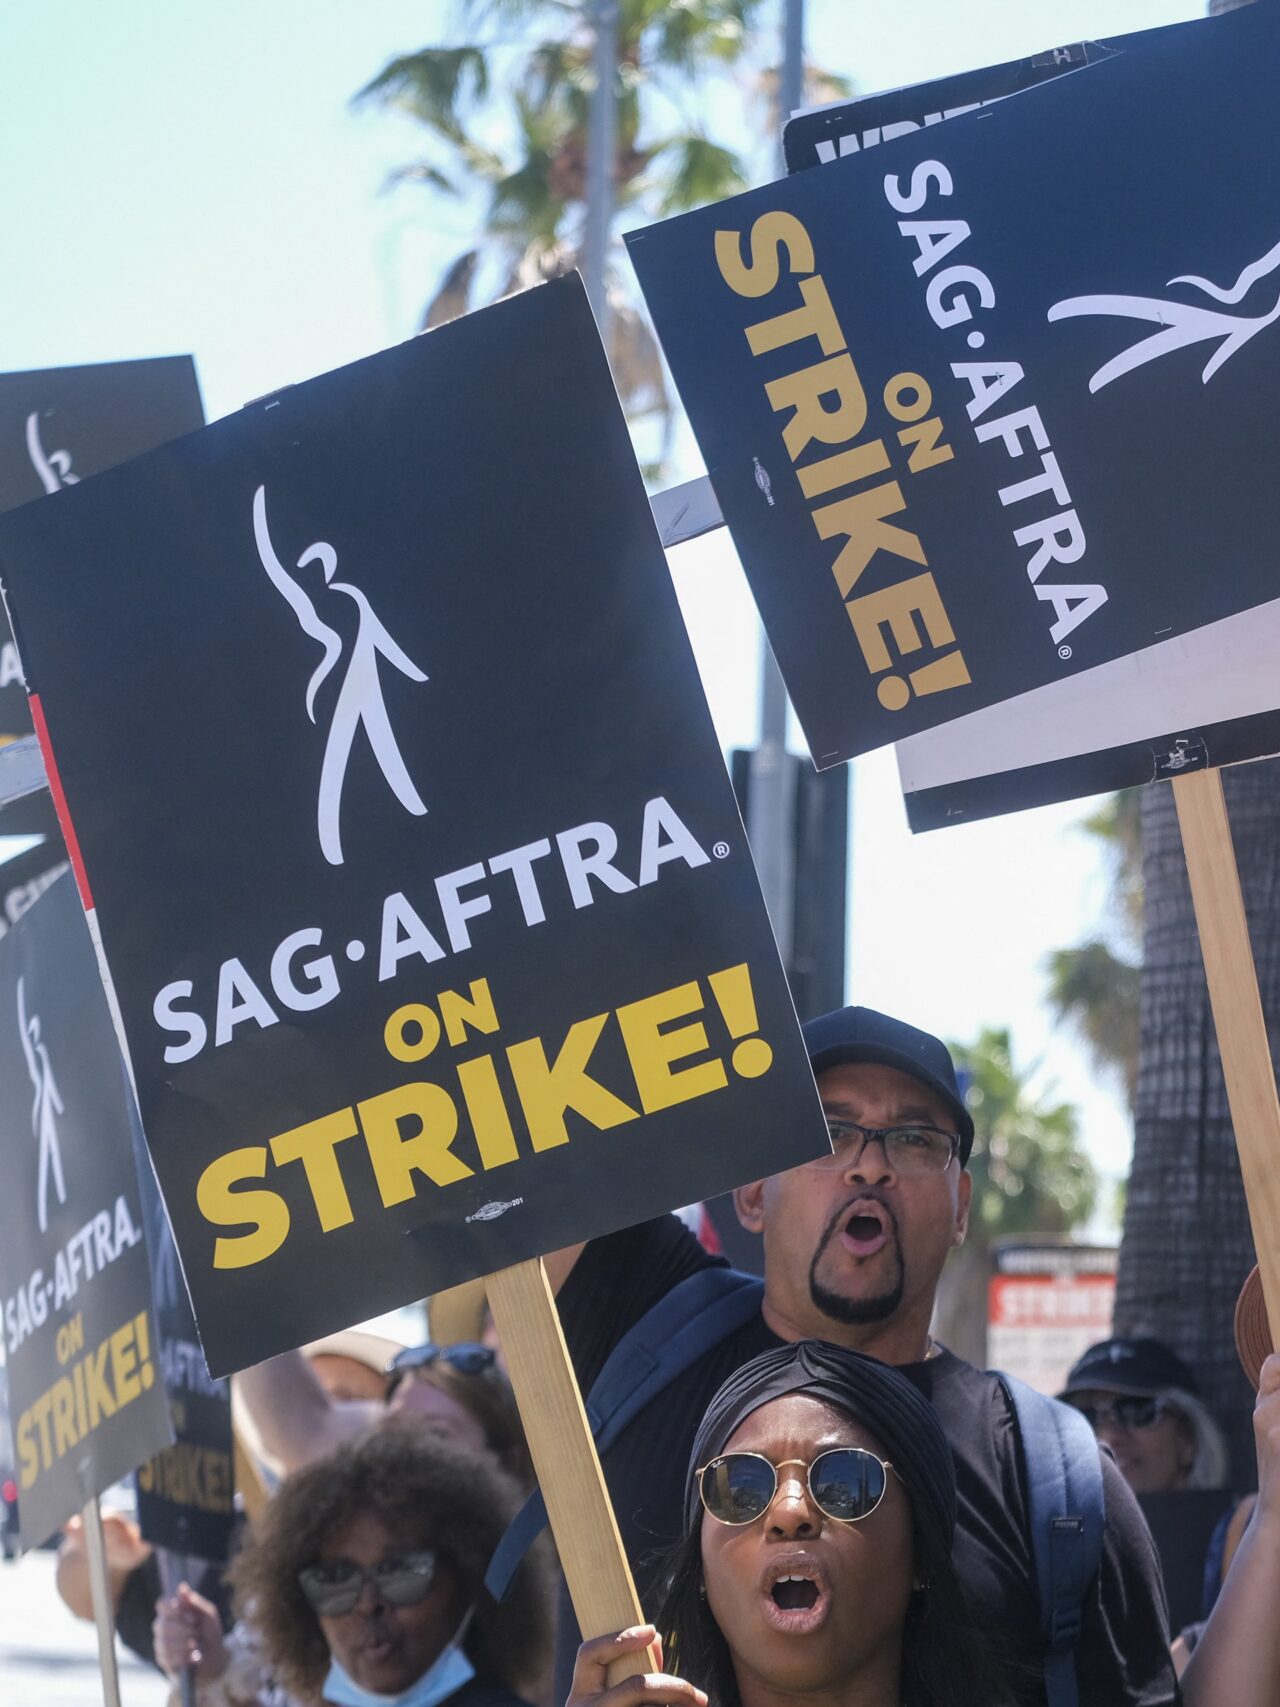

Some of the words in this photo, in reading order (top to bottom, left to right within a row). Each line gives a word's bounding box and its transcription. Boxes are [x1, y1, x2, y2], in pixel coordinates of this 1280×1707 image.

[715, 211, 971, 711] STRIKE!
[884, 373, 953, 473] ON
[383, 977, 500, 1063] ON
[196, 962, 773, 1270] STRIKE!
[16, 1310, 154, 1490] STRIKE!
[56, 1311, 84, 1366] ON
